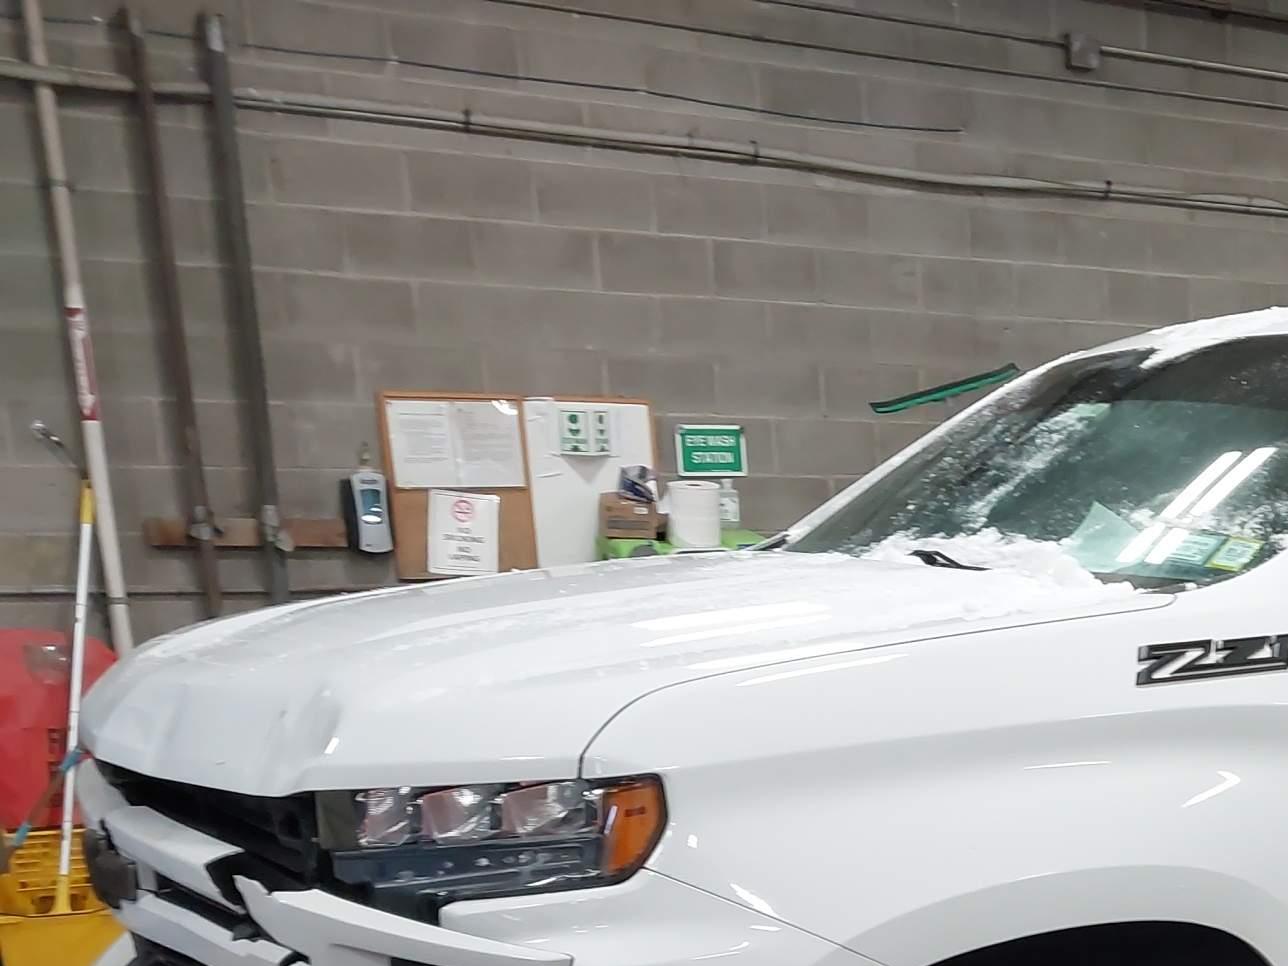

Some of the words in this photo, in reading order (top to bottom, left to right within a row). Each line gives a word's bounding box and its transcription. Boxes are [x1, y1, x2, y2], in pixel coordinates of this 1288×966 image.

[684, 435, 706, 447] EYE
[706, 435, 736, 447] WASH
[690, 451, 735, 464] STATION
